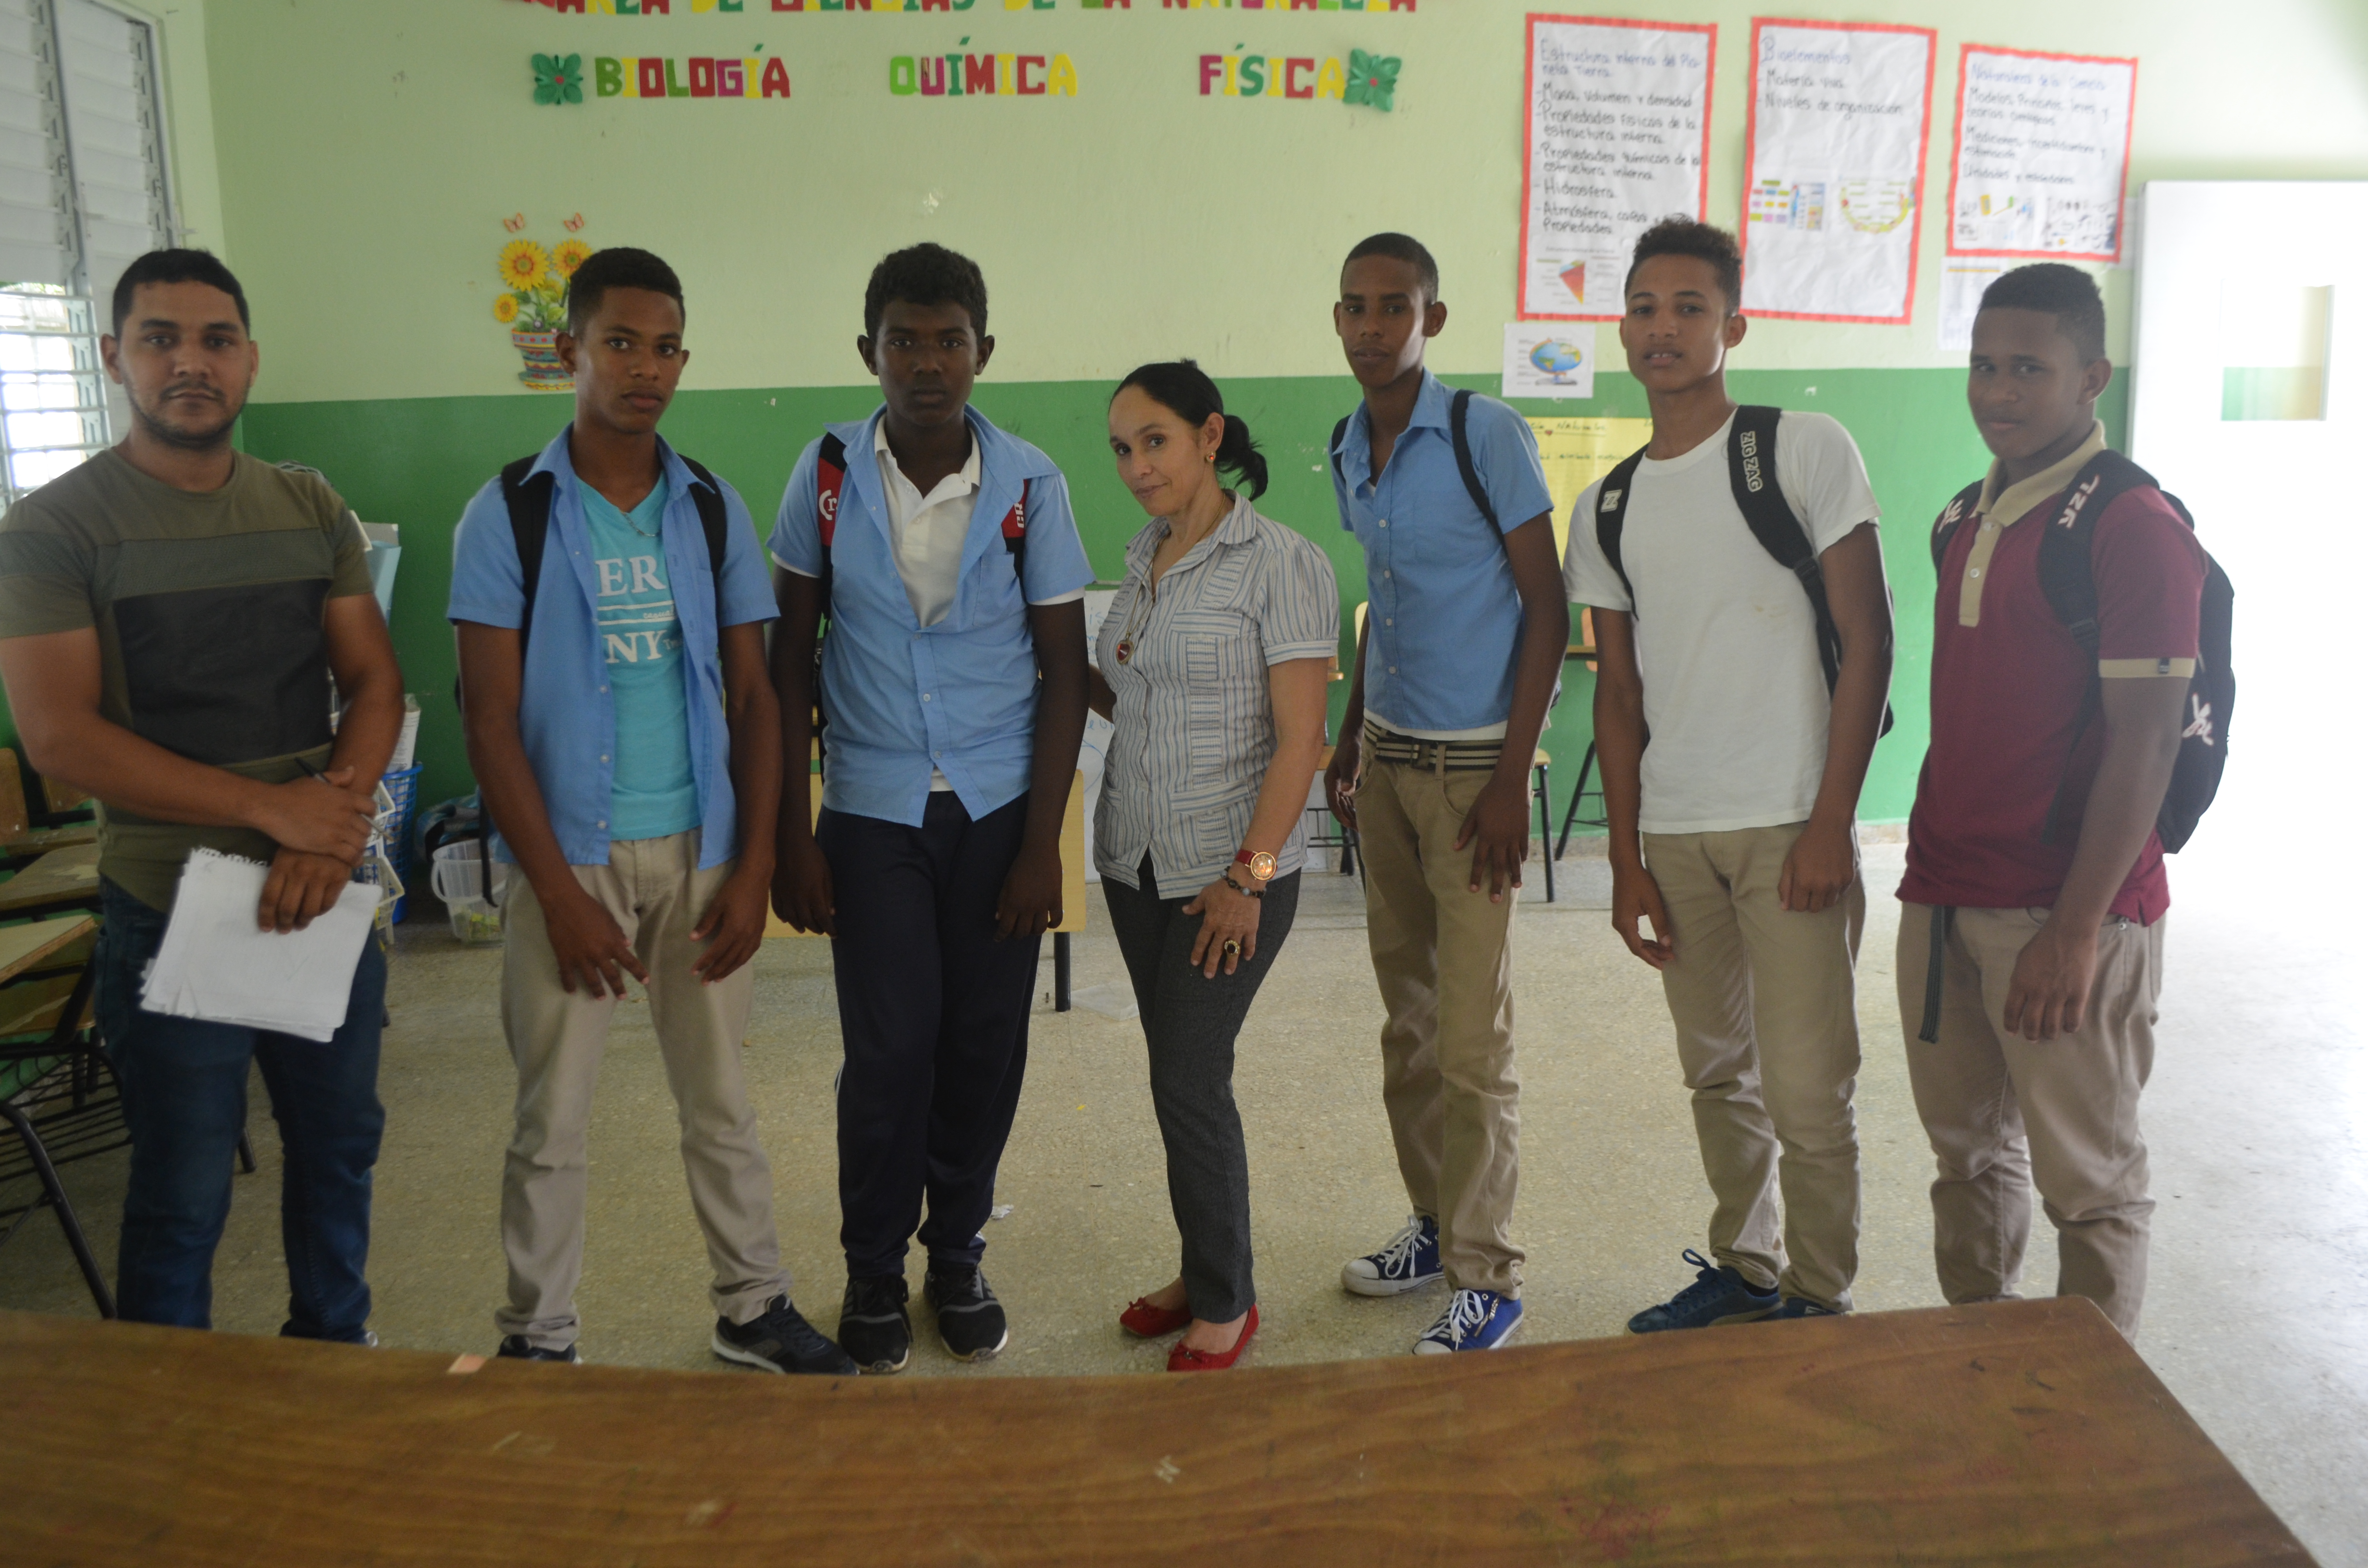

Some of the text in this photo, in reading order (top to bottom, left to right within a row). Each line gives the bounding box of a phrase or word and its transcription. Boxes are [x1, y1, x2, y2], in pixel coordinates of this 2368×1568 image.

[595, 44, 790, 98] BIOLOGÍA
[889, 36, 1077, 96] QUÍMICA
[1200, 43, 1345, 99] FÍSICA
[1667, 115, 1680, 129] de
[1685, 116, 1696, 130] la
[1740, 430, 1764, 492] ZIG ZAG
[603, 630, 667, 664] NY
